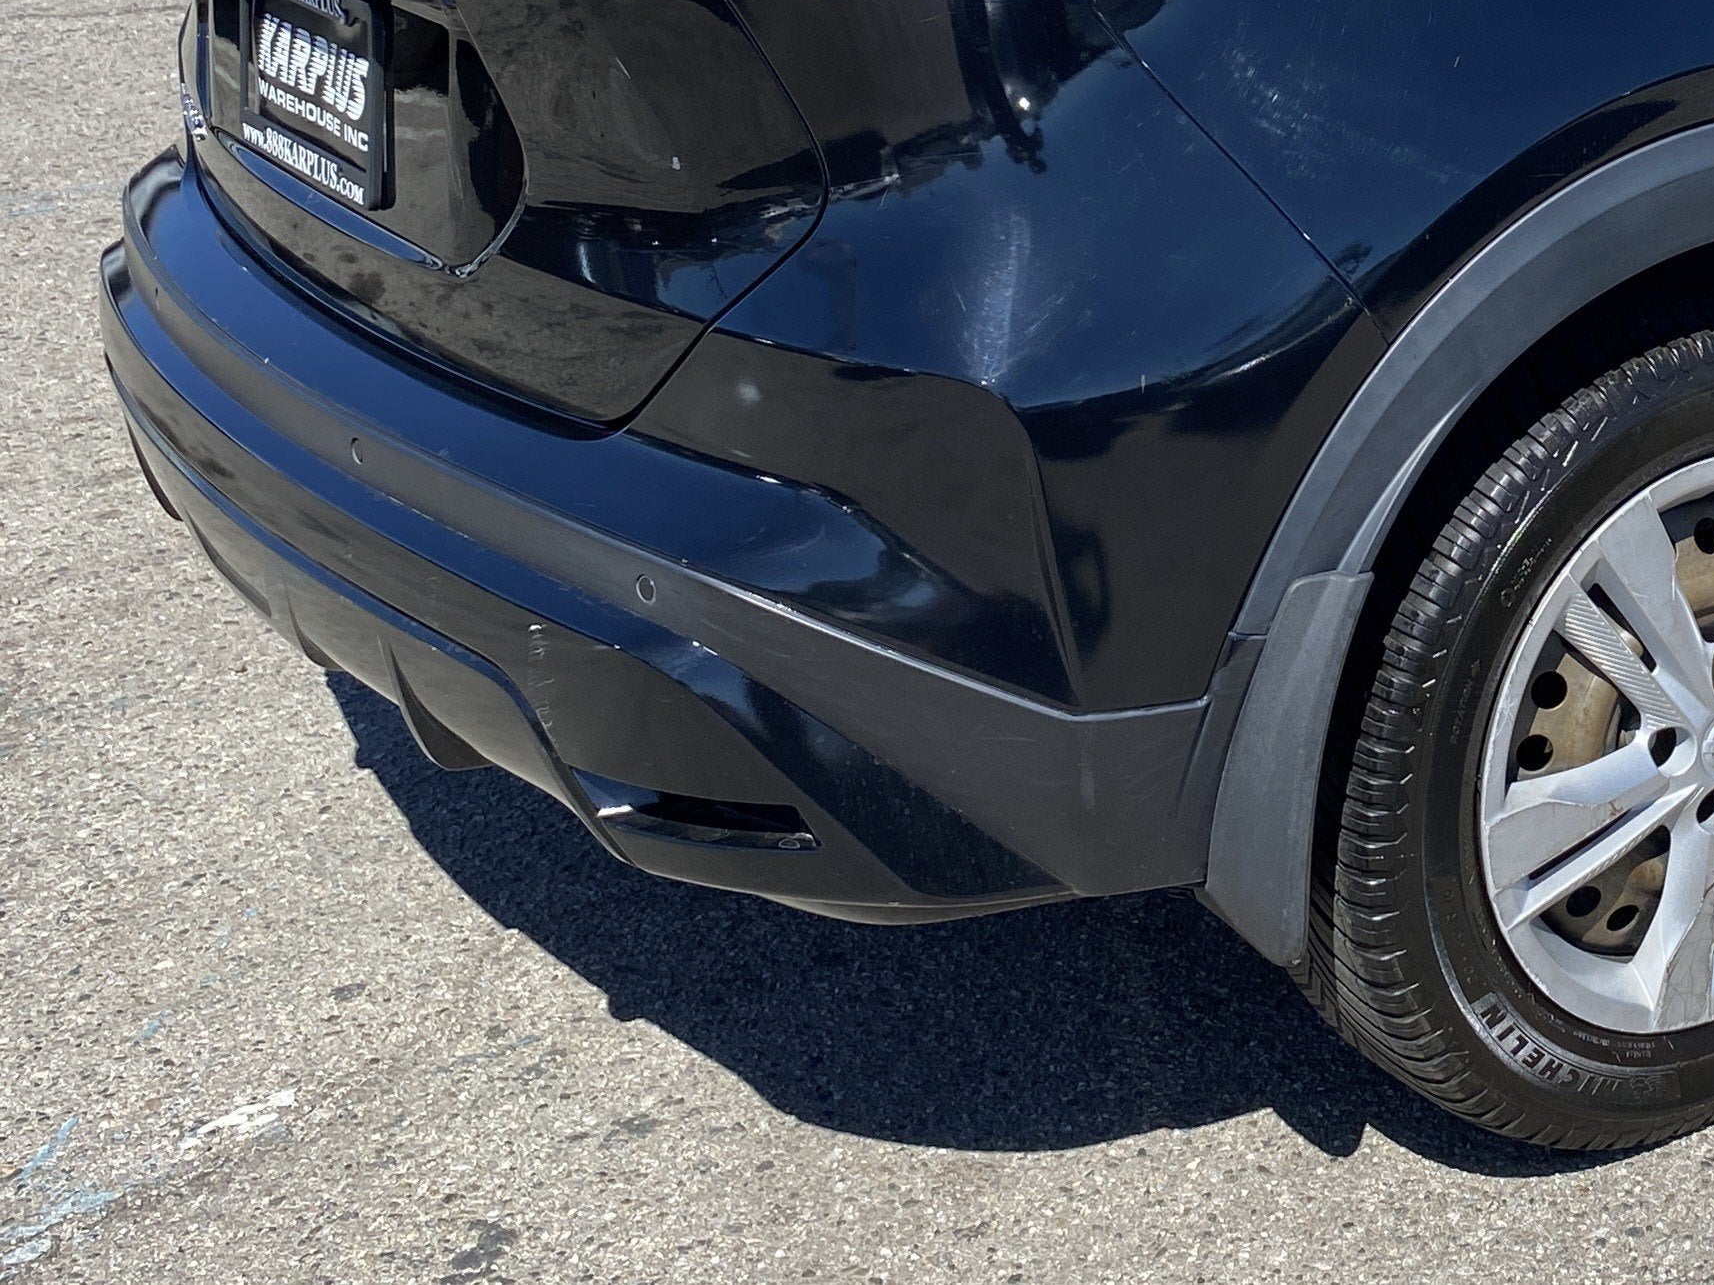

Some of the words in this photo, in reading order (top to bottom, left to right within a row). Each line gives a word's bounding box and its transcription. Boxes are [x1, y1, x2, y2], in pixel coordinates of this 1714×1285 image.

[257, 13, 370, 121] KARPLUS
[258, 77, 342, 138] WAREHOUSE
[344, 123, 369, 153] INC
[1480, 1002, 1621, 1097] MICHELIN
